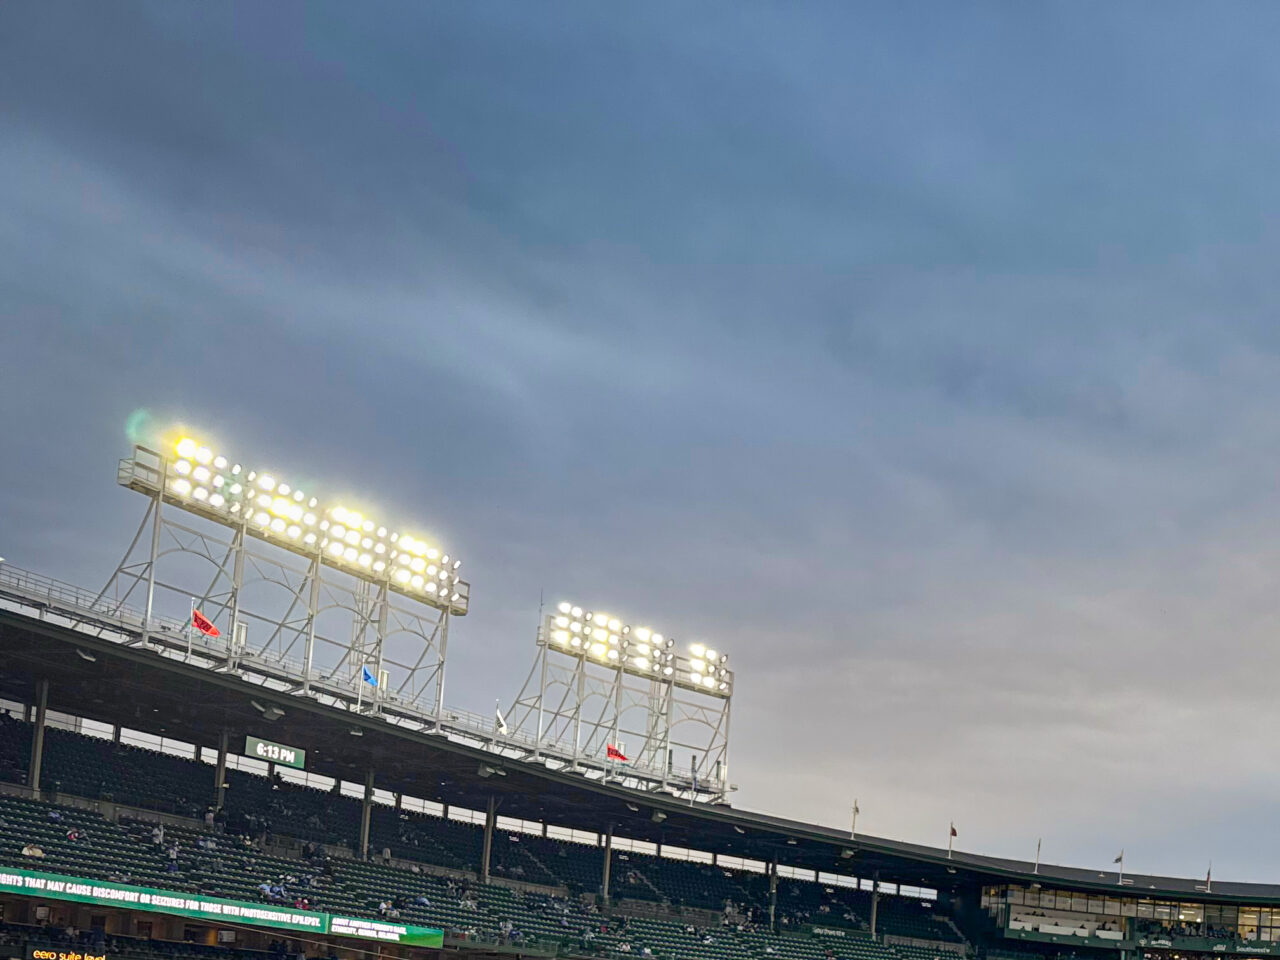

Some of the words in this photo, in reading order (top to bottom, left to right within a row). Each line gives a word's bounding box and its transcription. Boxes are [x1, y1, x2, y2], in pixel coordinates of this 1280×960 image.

[257, 743, 279, 759] 6:13
[281, 749, 295, 763] PM
[25, 877, 46, 889] THAT
[47, 880, 65, 892] MAY
[66, 883, 91, 896] CAUSE
[93, 887, 139, 902] DISCOMFORT
[140, 893, 151, 904] OR
[152, 895, 185, 909] SEIZURES
[186, 900, 199, 910] FOR
[200, 902, 222, 914] THOSE
[240, 908, 291, 923] PHOTOSENSITIVE
[33, 950, 56, 960] eero
